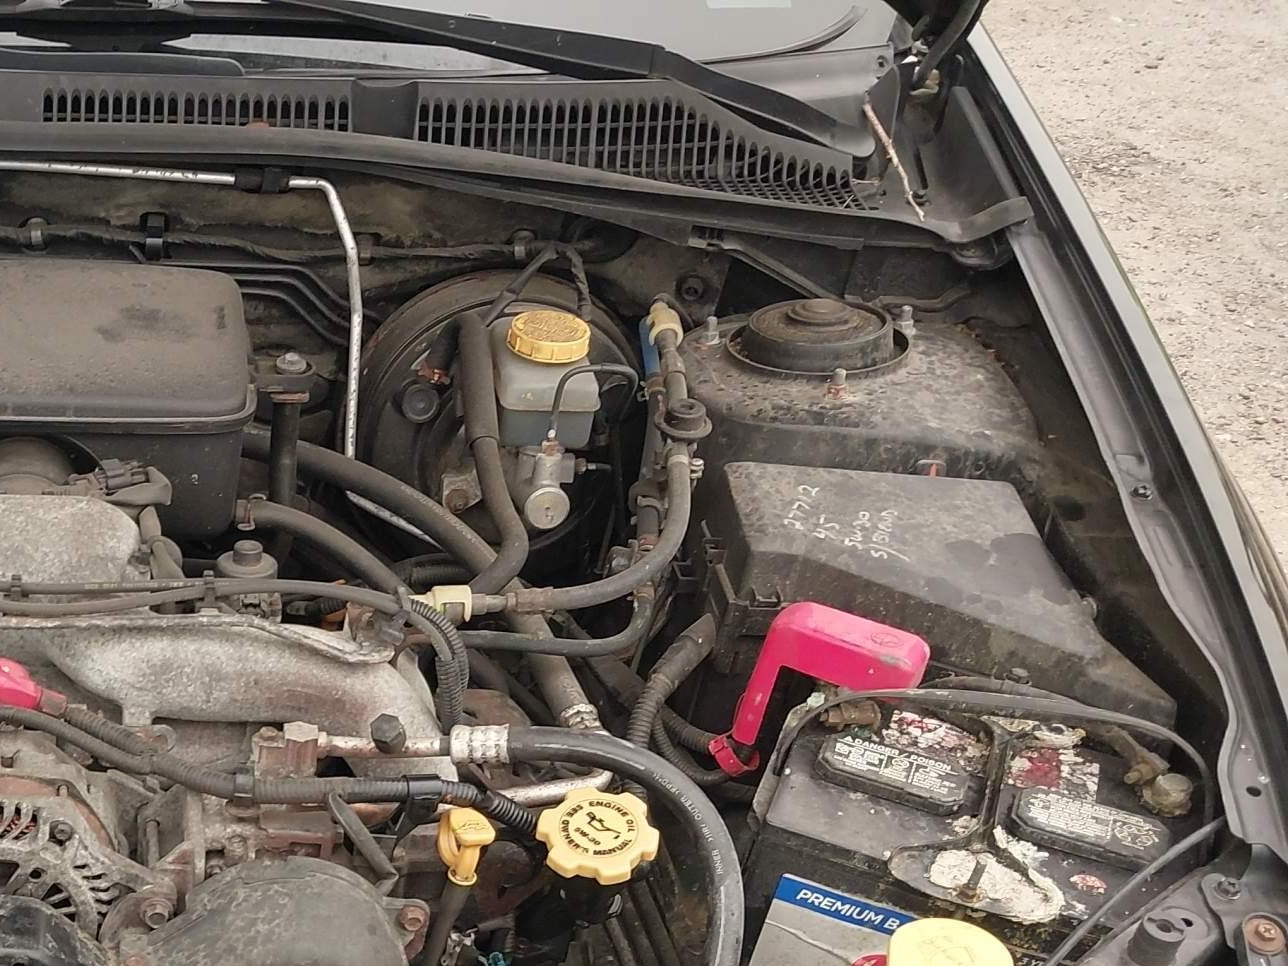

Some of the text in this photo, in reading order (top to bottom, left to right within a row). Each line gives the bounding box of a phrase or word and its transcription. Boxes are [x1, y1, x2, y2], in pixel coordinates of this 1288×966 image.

[855, 738, 900, 756] DANGER
[909, 753, 952, 772] POISON
[588, 801, 636, 833] ENGINE OIL
[680, 794, 702, 820] OUTER
[593, 839, 633, 856] MANUAL
[795, 888, 884, 926] PREMIUM
